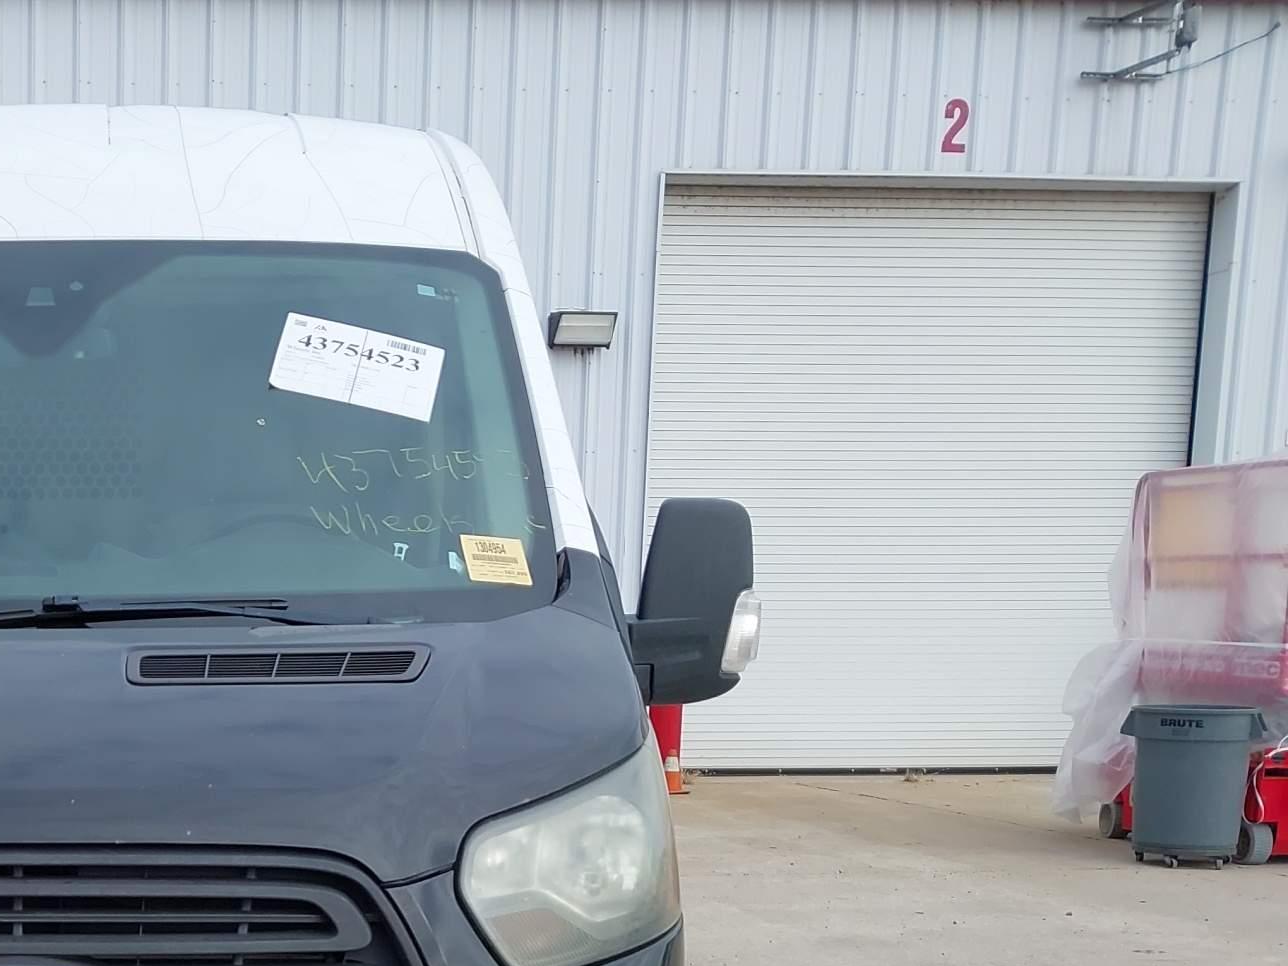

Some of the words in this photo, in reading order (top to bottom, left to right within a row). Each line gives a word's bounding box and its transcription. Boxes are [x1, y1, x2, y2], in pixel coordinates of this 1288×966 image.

[941, 98, 969, 153] 2
[297, 334, 420, 373] 43754523
[1160, 718, 1205, 728] BRUTE
